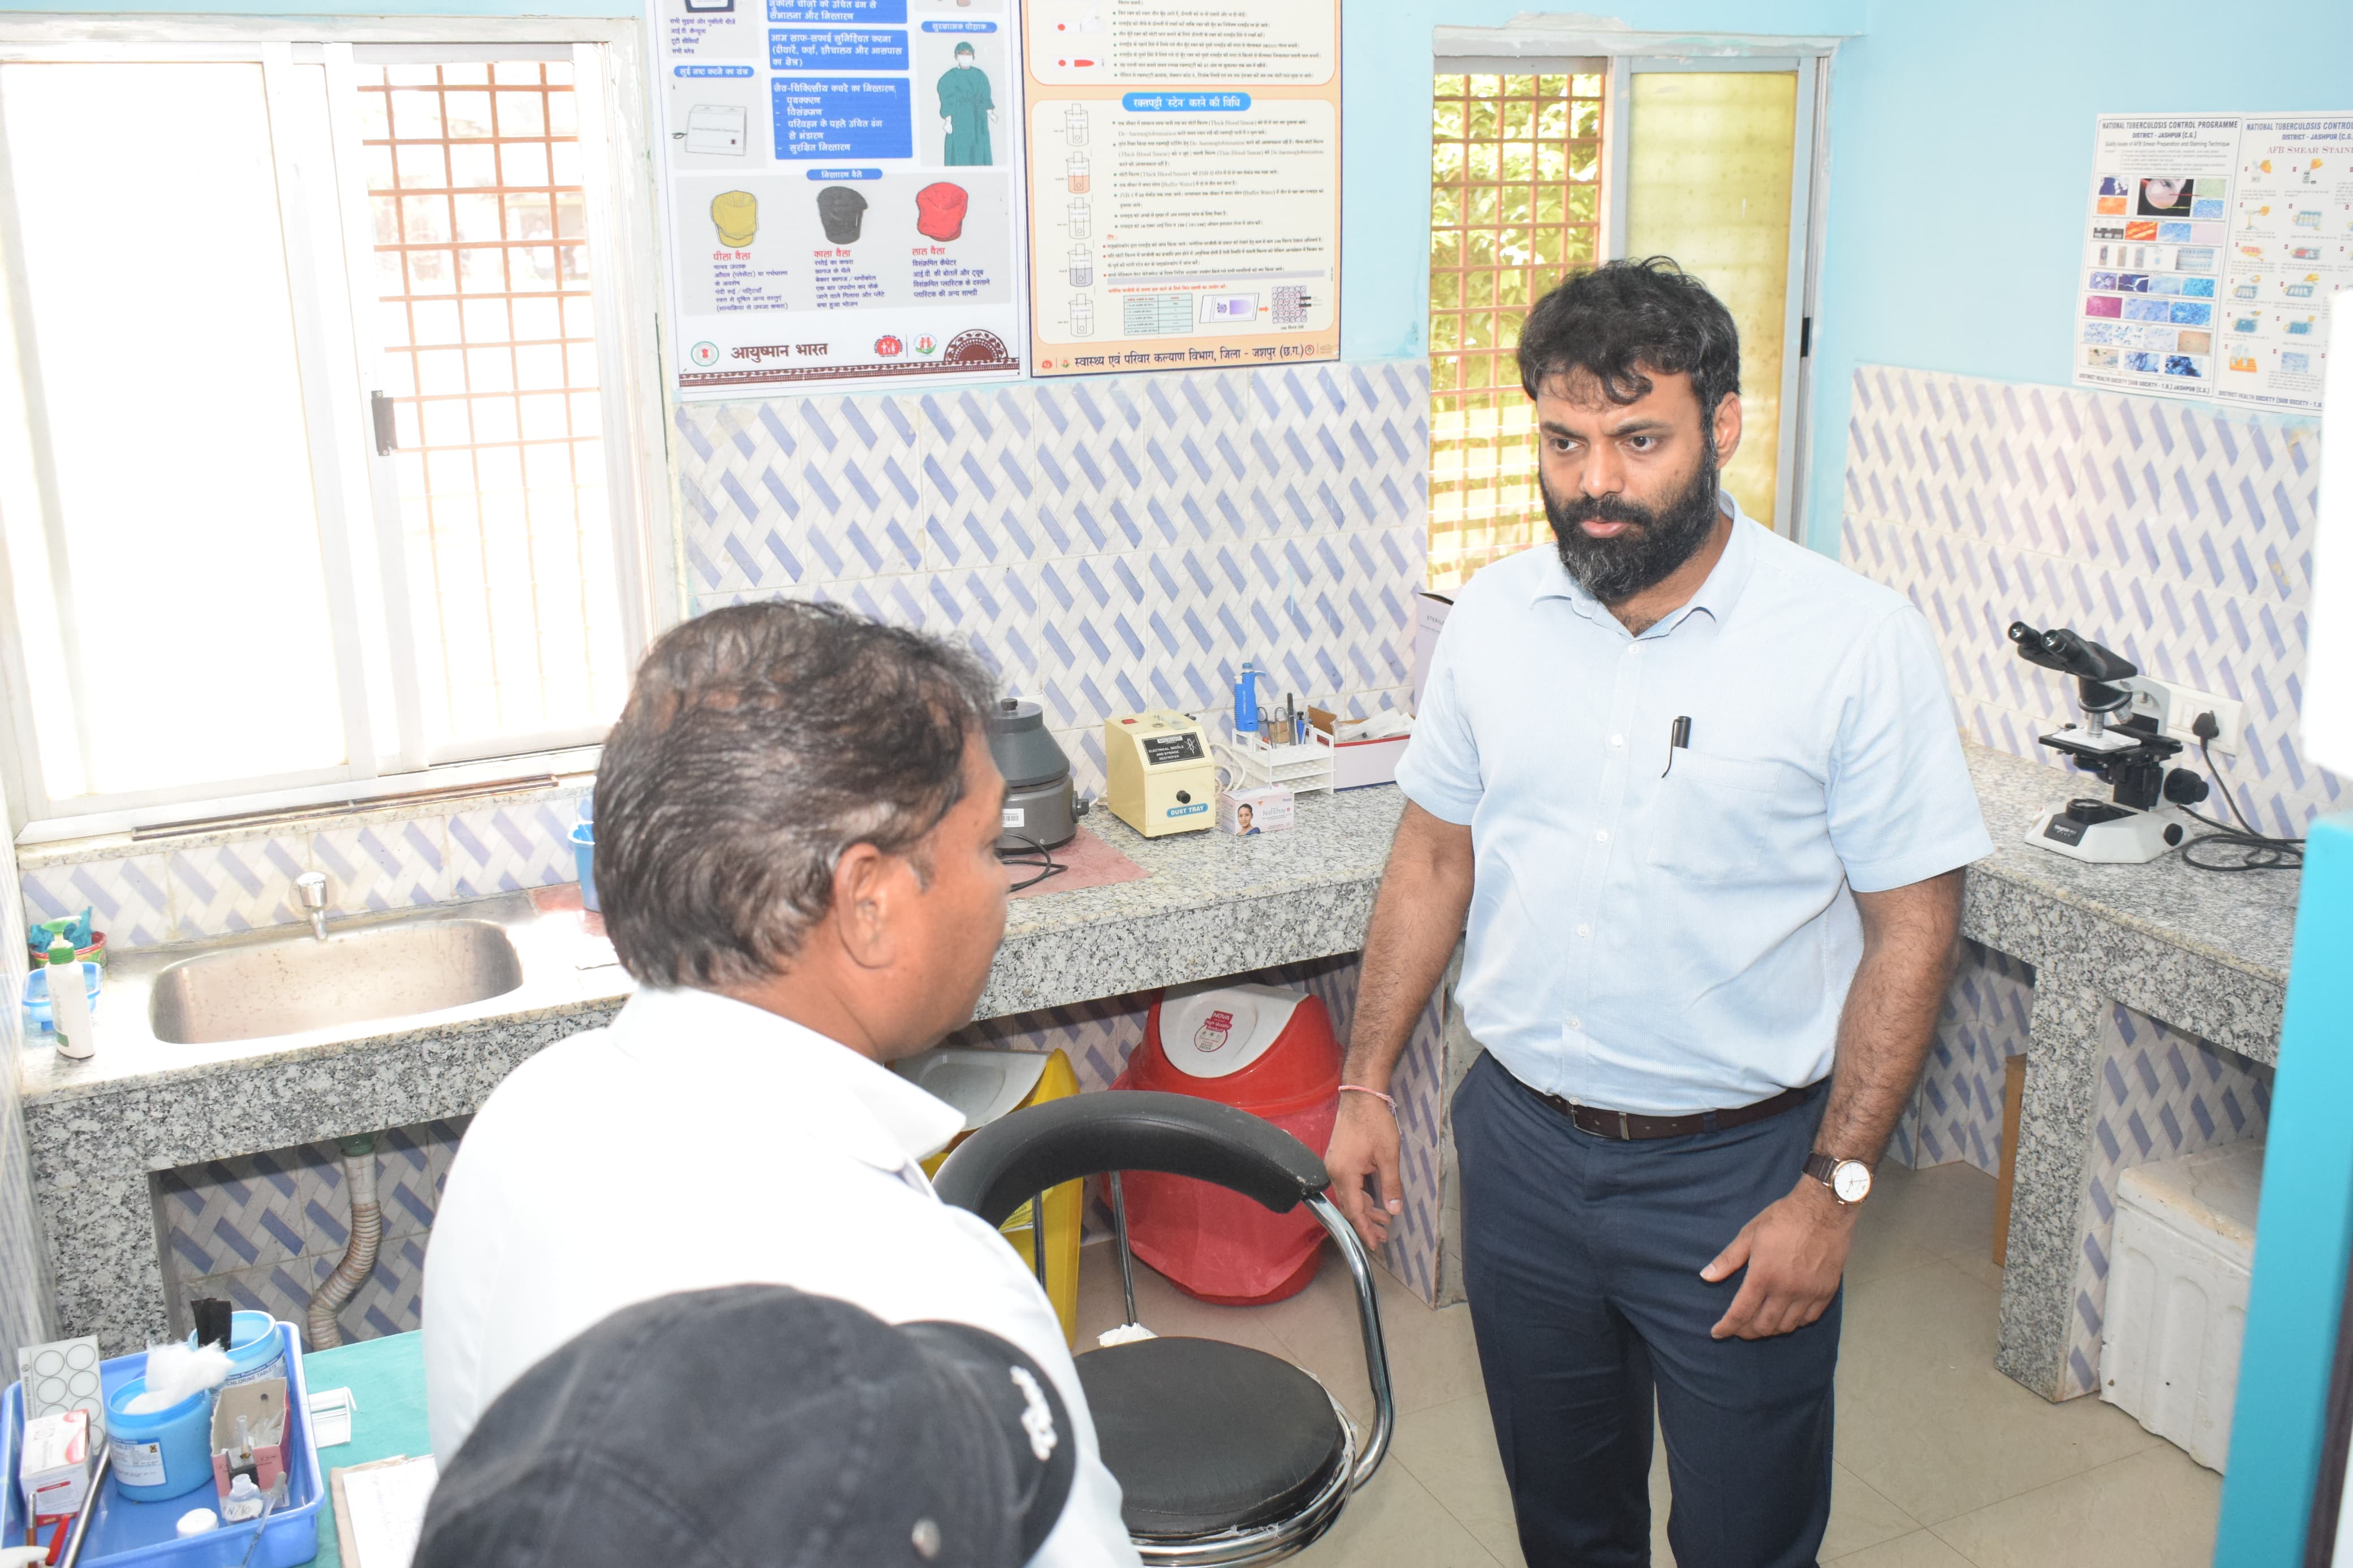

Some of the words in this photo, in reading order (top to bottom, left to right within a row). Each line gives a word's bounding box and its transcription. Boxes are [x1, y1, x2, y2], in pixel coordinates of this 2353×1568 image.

[805, 11, 818, 20] और
[822, 11, 854, 20] निस्तारण
[932, 23, 963, 32] सुरक्षात्मक
[966, 22, 986, 31] पोशाक
[790, 32, 831, 42] साफ-सफाई
[835, 33, 869, 45] सुनिश्चित
[821, 44, 852, 54] शौचालय
[855, 44, 869, 54] और
[680, 66, 690, 77] सुई
[708, 67, 723, 75] करने
[774, 83, 828, 93] जैव-चिकित्सीय
[831, 83, 848, 92] कचरे
[864, 84, 895, 93] निस्तारण
[1134, 97, 1162, 110] रक्तपट्टी
[1189, 97, 1206, 107] करने
[1209, 96, 1220, 107] की
[1223, 96, 1240, 107] विधि
[788, 119, 817, 127] परिवहन
[830, 119, 846, 128] पहले
[849, 119, 868, 127] उचित
[871, 118, 883, 127] ढंग
[789, 131, 796, 140] से
[799, 130, 824, 140] भंडारण
[789, 142, 816, 154] सुरक्षित
[819, 142, 851, 151] निस्तारण
[821, 170, 849, 178] निस्तारण
[852, 170, 862, 178] थैले
[713, 250, 731, 261] पीला
[735, 250, 751, 261] थैला
[836, 247, 851, 258] थैला
[930, 245, 945, 255] थैला
[731, 345, 790, 363] आयुष्मान
[796, 343, 828, 356] भारत
[1075, 356, 1105, 367] स्वास्थ्य
[1109, 352, 1121, 368] एवं
[1124, 351, 1150, 364] परिवार
[1154, 352, 1185, 362] कल्याण
[1189, 348, 1216, 361] विभाग,
[1220, 346, 1240, 359] जिला
[1252, 347, 1275, 360] जशपुर
[226, 1375, 255, 1386] CHLORINE
